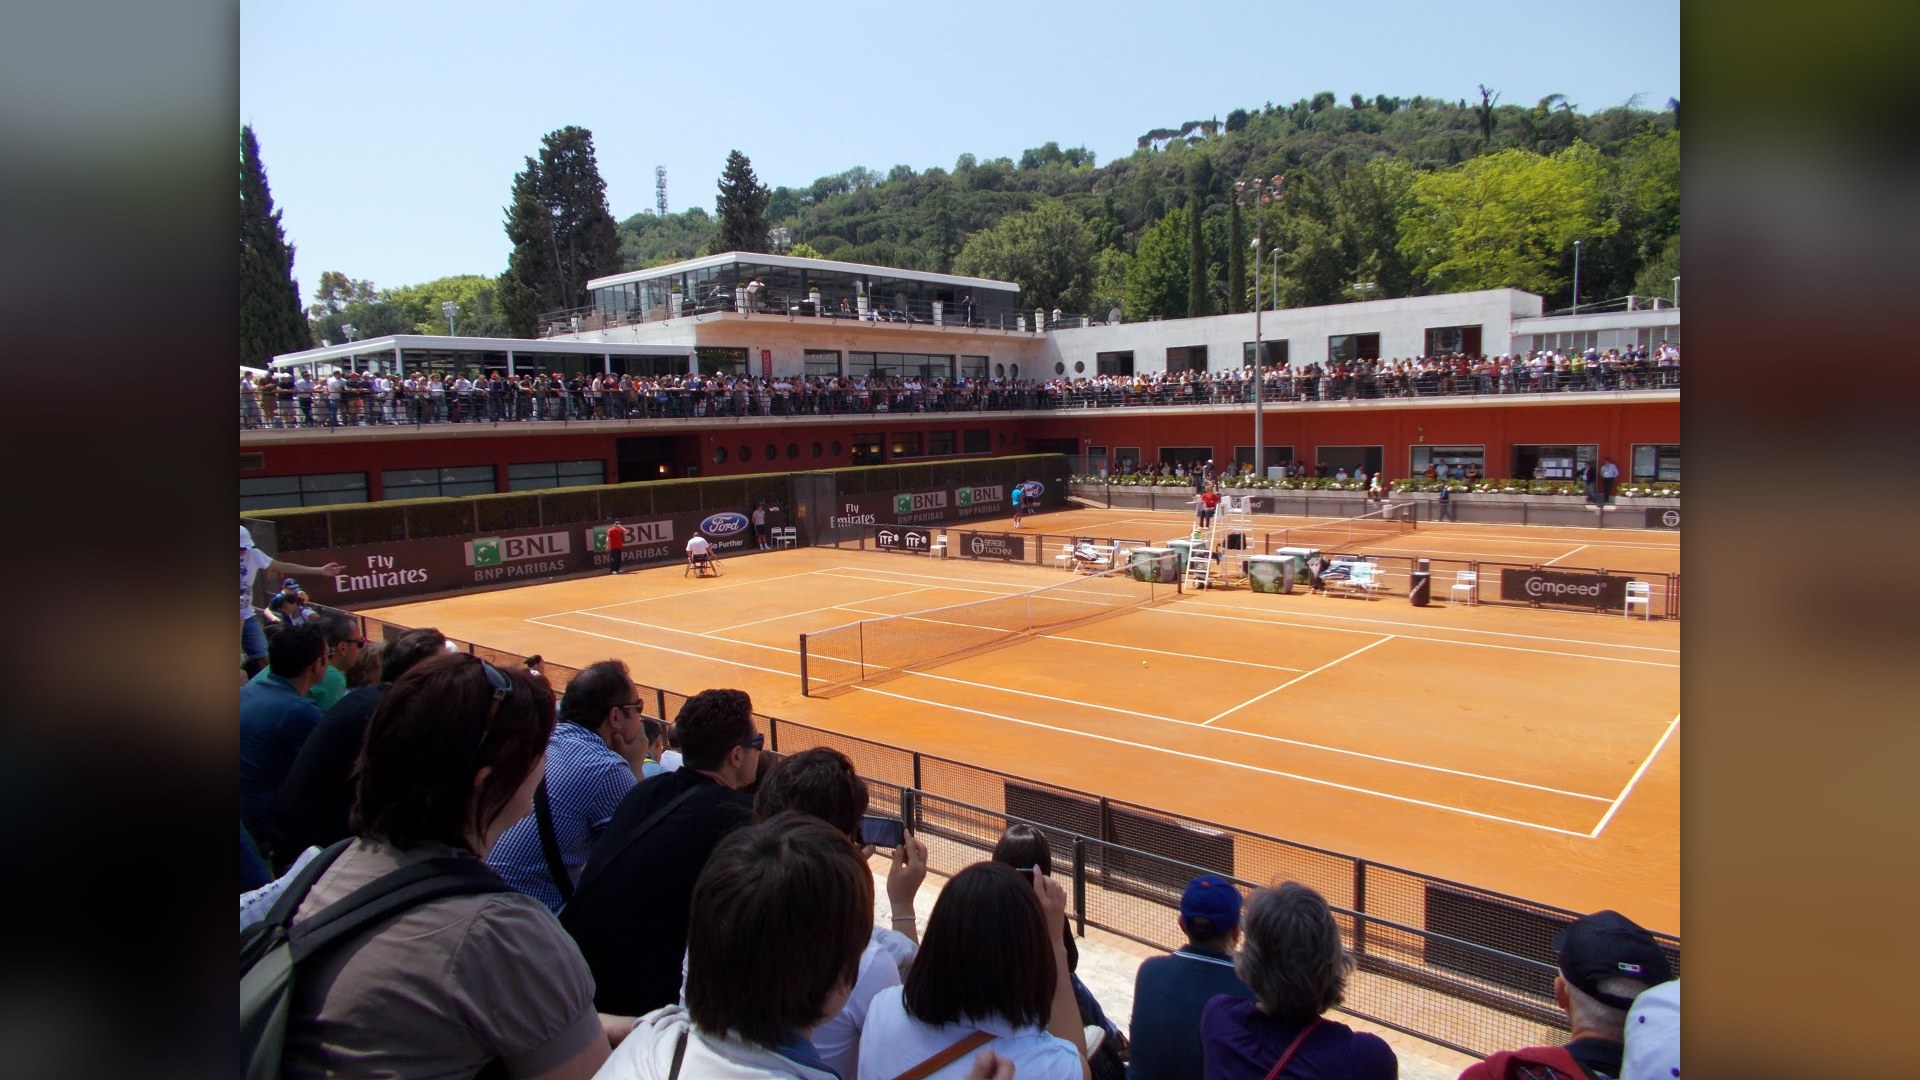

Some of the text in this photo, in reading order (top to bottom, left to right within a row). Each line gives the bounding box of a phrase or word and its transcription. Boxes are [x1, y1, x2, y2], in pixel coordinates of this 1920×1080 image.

[973, 487, 999, 501] BNL
[845, 503, 859, 513] Fly
[913, 494, 943, 509] BNL
[959, 503, 1000, 516] BNP PARIBAS
[709, 516, 740, 533] Ford
[897, 511, 944, 525] BNP PARIBAS
[622, 523, 668, 544] BNL
[879, 535, 893, 545] ITF
[505, 535, 563, 558] BNL
[718, 539, 743, 548] Further
[905, 537, 920, 547] ITF
[984, 539, 1006, 547] SERGIO
[620, 546, 669, 562] PARIBAS
[984, 546, 1012, 555] TACCHINI
[367, 555, 394, 569] Fly
[474, 560, 565, 581] BNP PARIBAS
[335, 568, 428, 592] Emirates
[1526, 576, 1600, 596] Compeed
